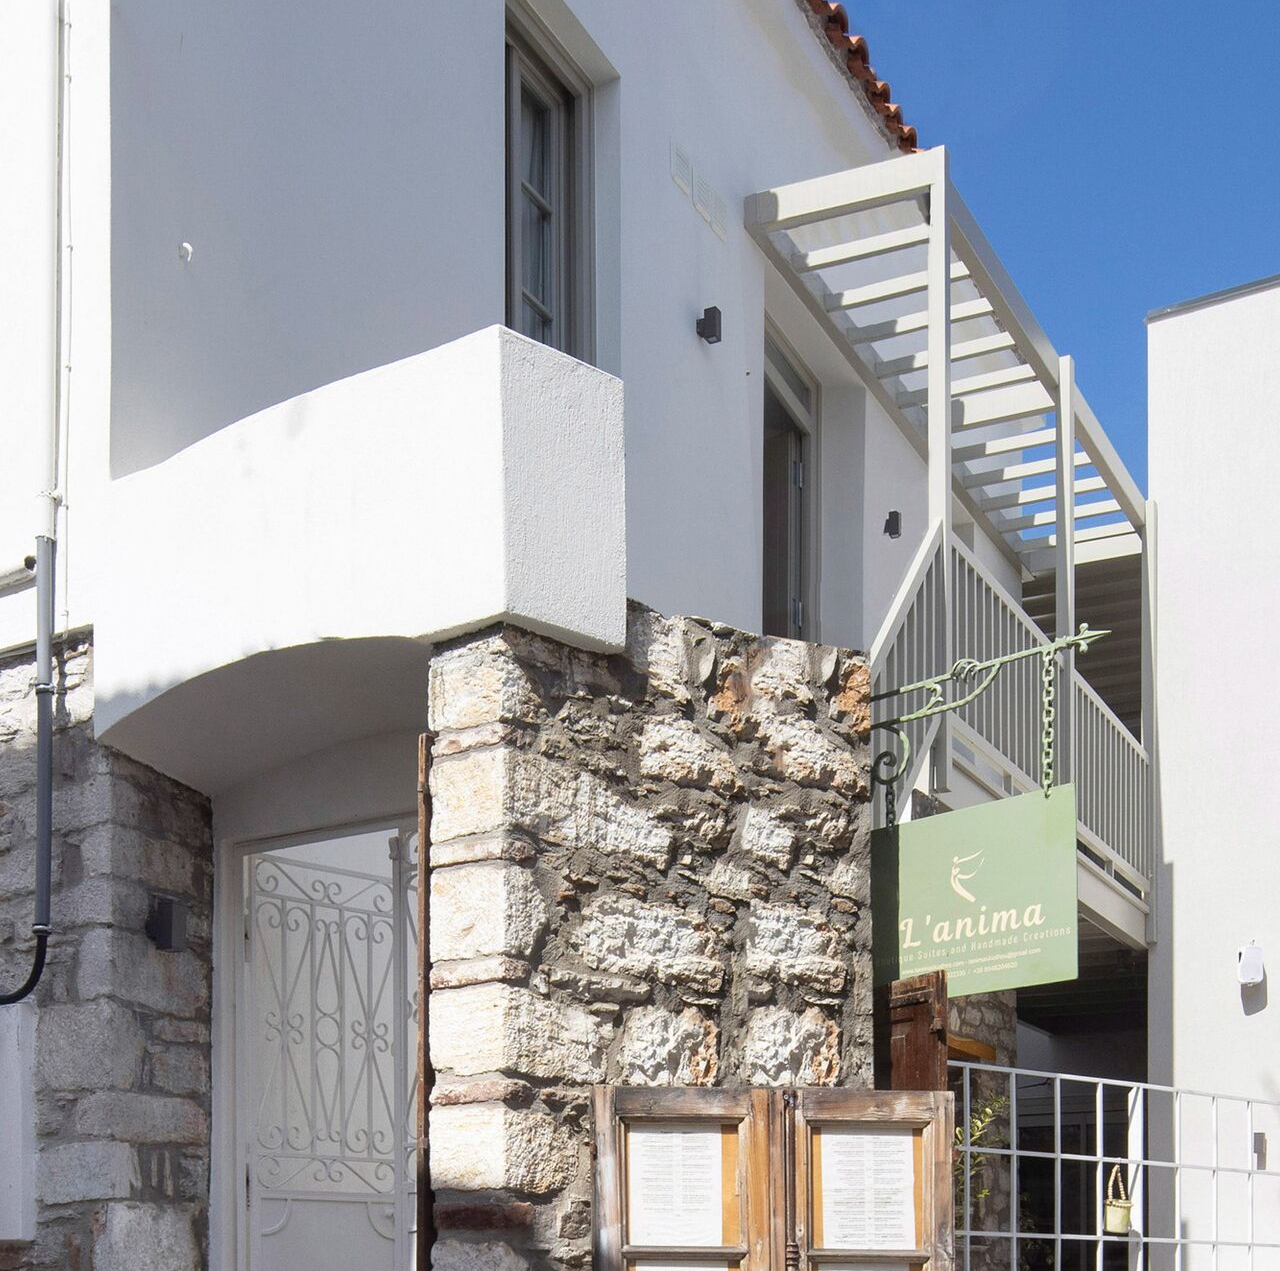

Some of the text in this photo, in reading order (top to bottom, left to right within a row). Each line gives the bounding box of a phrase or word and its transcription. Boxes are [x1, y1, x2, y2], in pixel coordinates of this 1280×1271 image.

[899, 903, 1046, 949] L'anima
[918, 949, 947, 961] Suites
[950, 943, 968, 955] and
[971, 935, 1018, 951] Handmade
[1023, 926, 1071, 942] Creations
